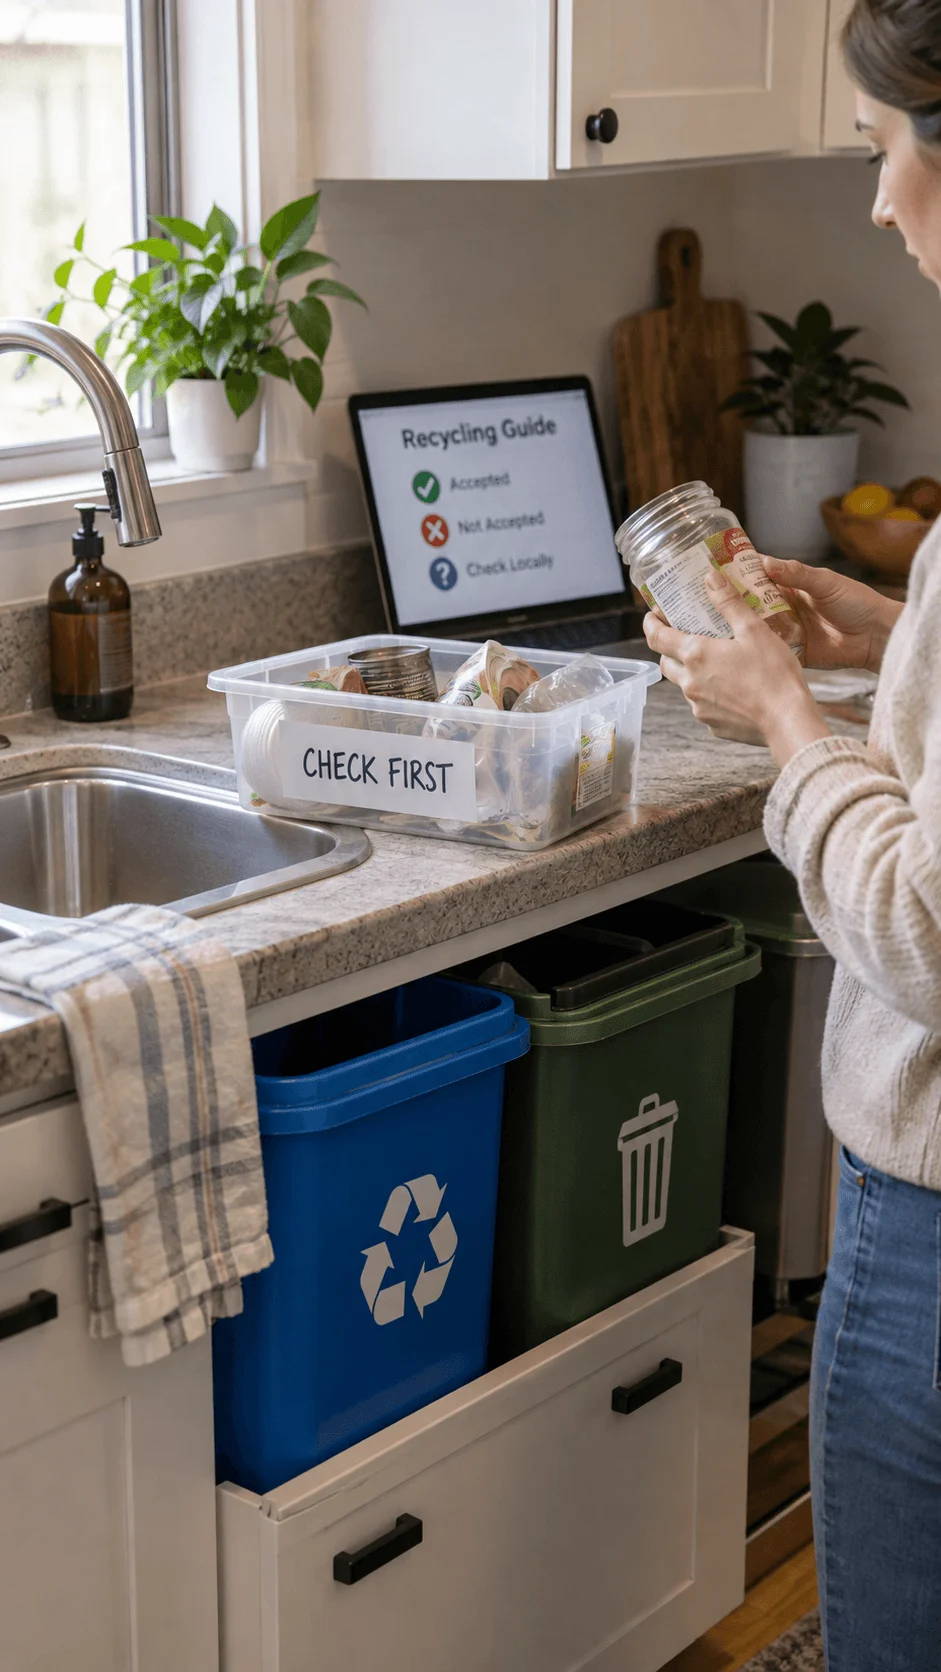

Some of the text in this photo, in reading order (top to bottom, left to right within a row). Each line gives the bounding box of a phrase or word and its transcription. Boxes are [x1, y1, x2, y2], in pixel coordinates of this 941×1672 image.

[401, 415, 557, 450] Recycling Guide
[450, 471, 511, 492] Accepted
[458, 512, 545, 536] Not Accepted
[466, 553, 554, 578] Check Locally
[302, 747, 454, 794] CHECK FIRST
